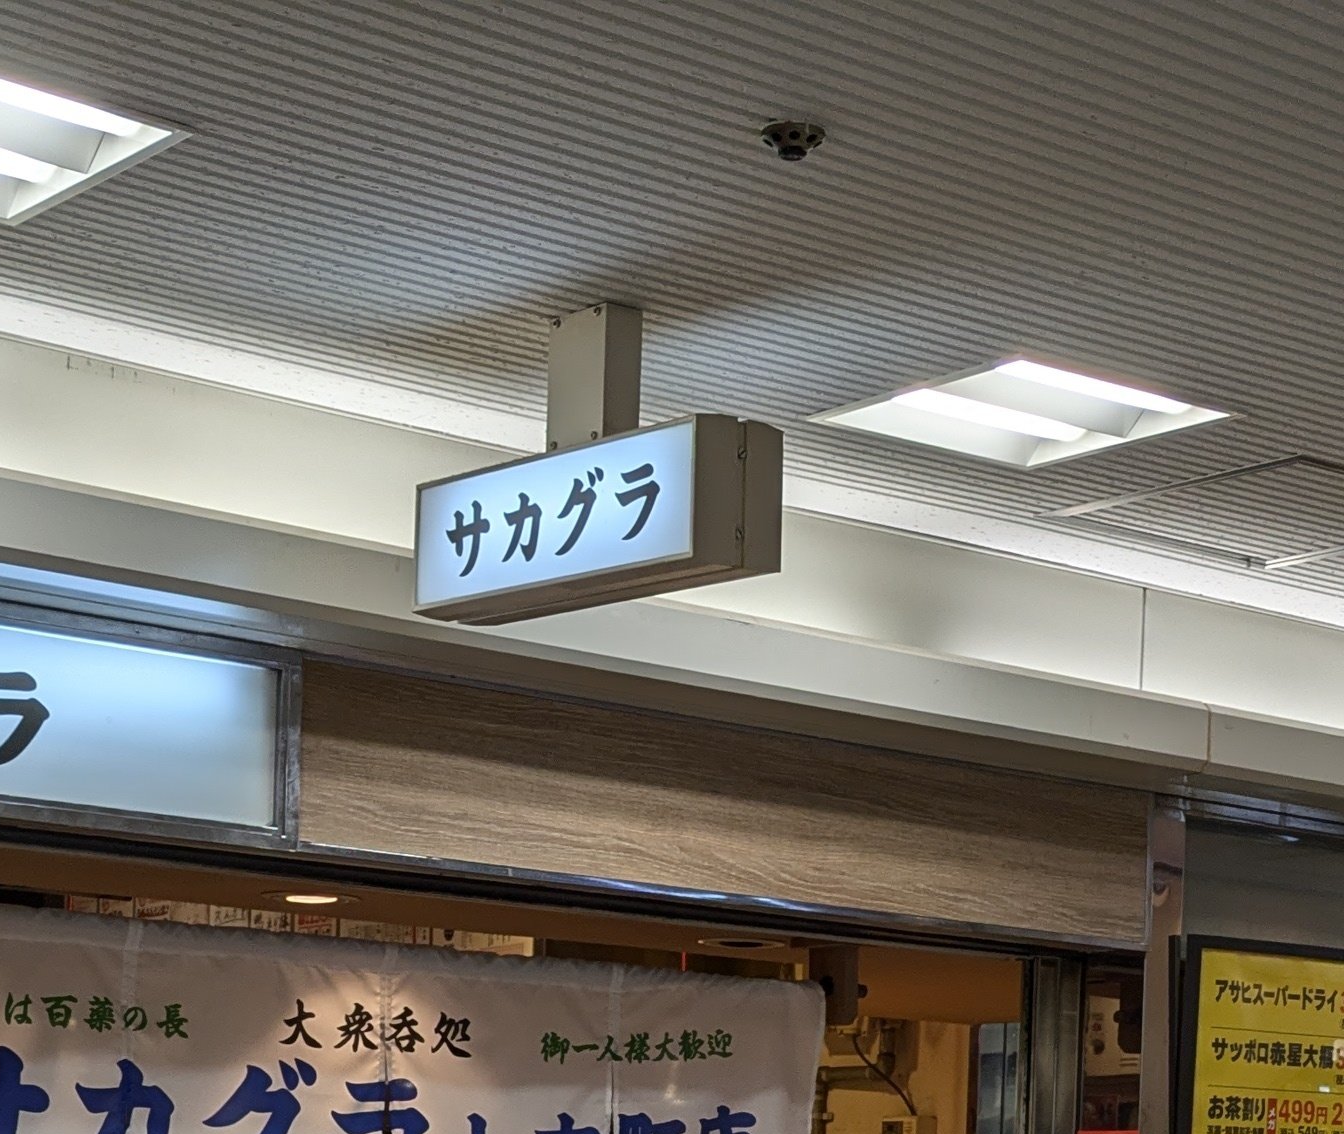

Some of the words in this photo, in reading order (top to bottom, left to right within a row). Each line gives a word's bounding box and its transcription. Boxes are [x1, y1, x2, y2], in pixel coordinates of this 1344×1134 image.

[447, 462, 662, 578] サカグラ
[1214, 979, 1339, 1013] アサヒスーパードライ
[281, 1002, 474, 1059] 大衆呑処
[539, 1026, 736, 1067] 御一人様大歓迎
[1211, 1037, 1334, 1070] サッポロ赤星大瓶
[1207, 1095, 1266, 1122] お茶割り
[1278, 1099, 1328, 1125] 499円
